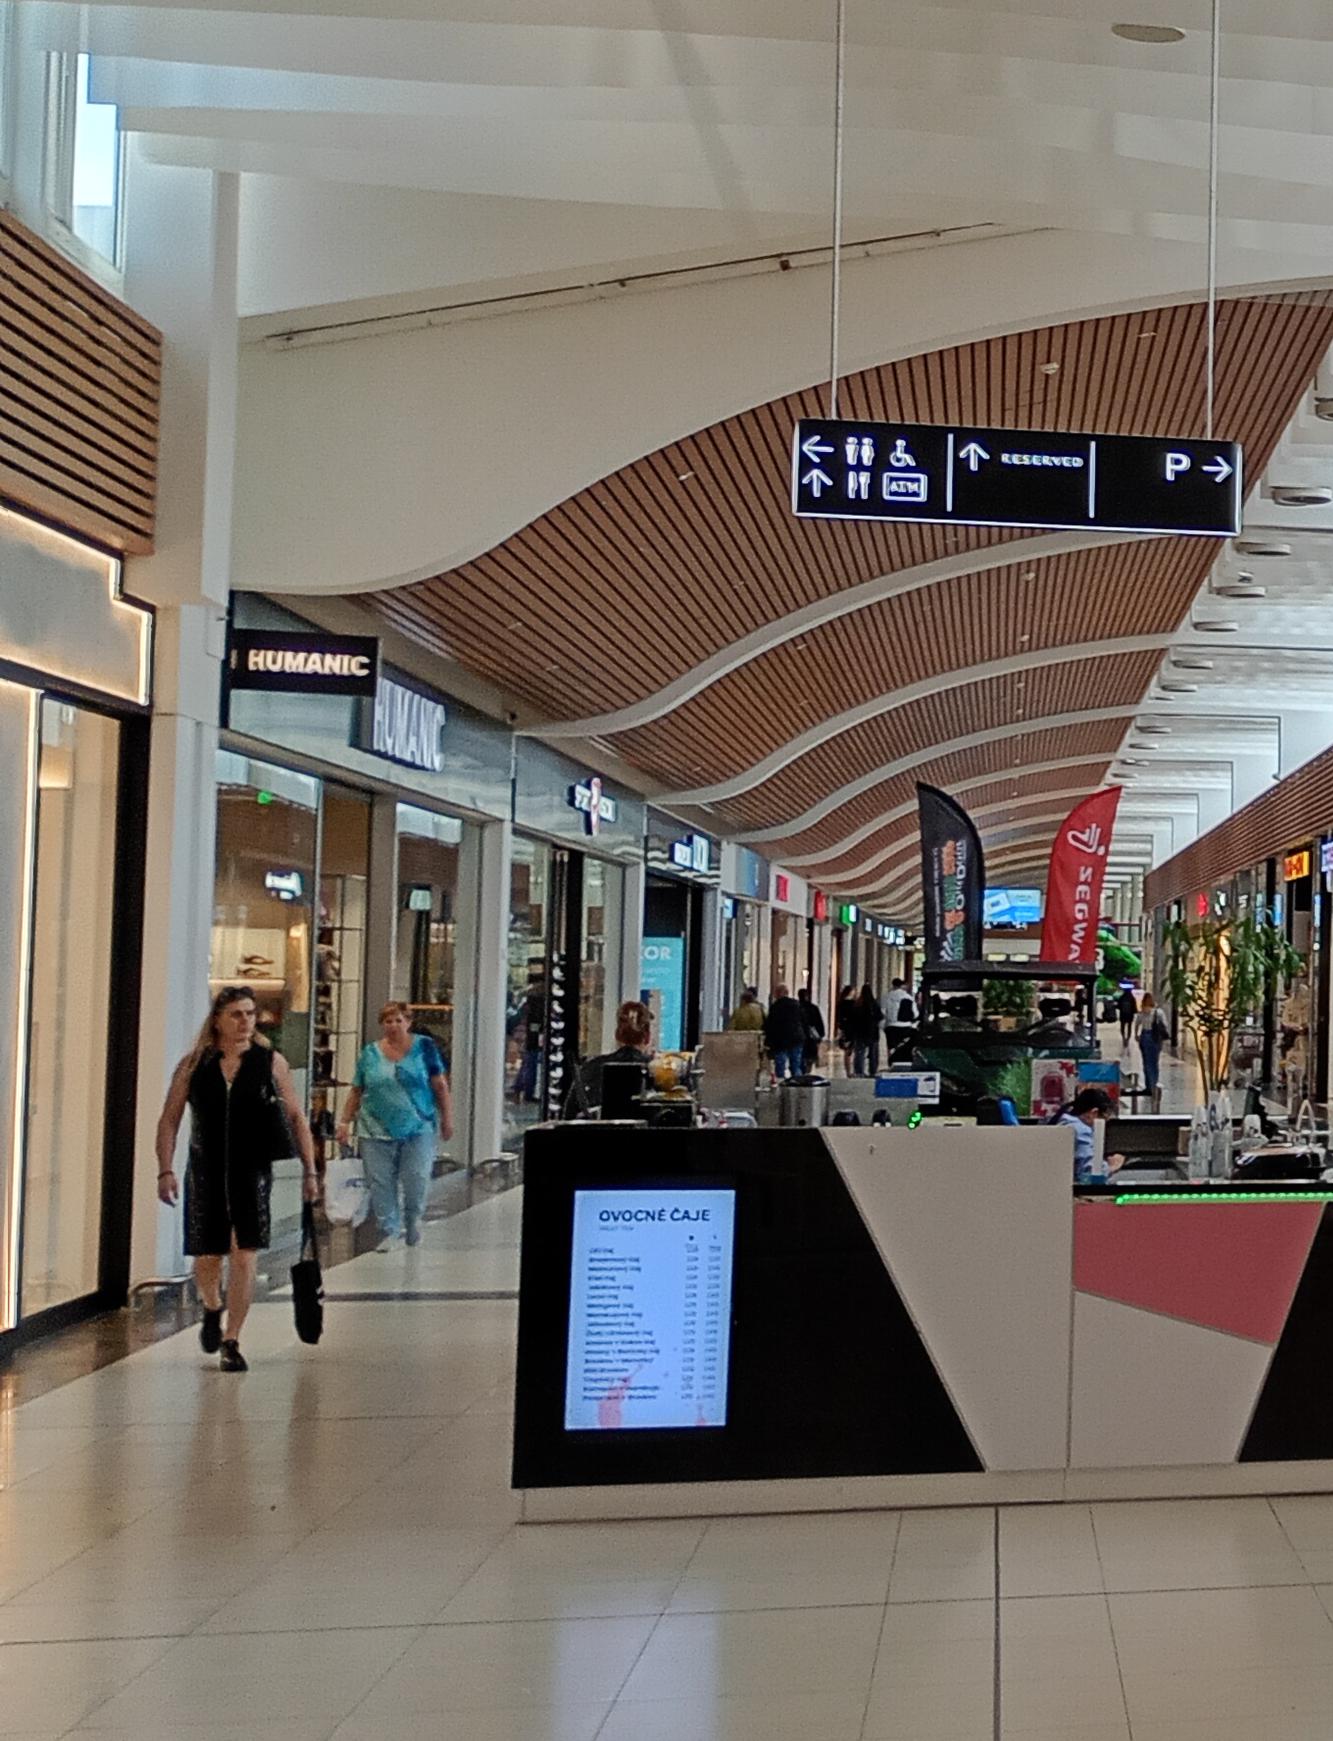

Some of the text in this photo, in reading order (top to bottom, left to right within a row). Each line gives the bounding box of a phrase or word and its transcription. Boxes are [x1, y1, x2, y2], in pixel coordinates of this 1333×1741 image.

[1001, 453, 1083, 468] RESERVED
[1166, 453, 1190, 480] P
[889, 480, 921, 495] ATM
[248, 649, 371, 677] HUMANIC
[374, 676, 446, 772] HUMANIC
[1068, 865, 1093, 963] SEGWA
[599, 1207, 710, 1222] OVOCNÉ ČAJE
